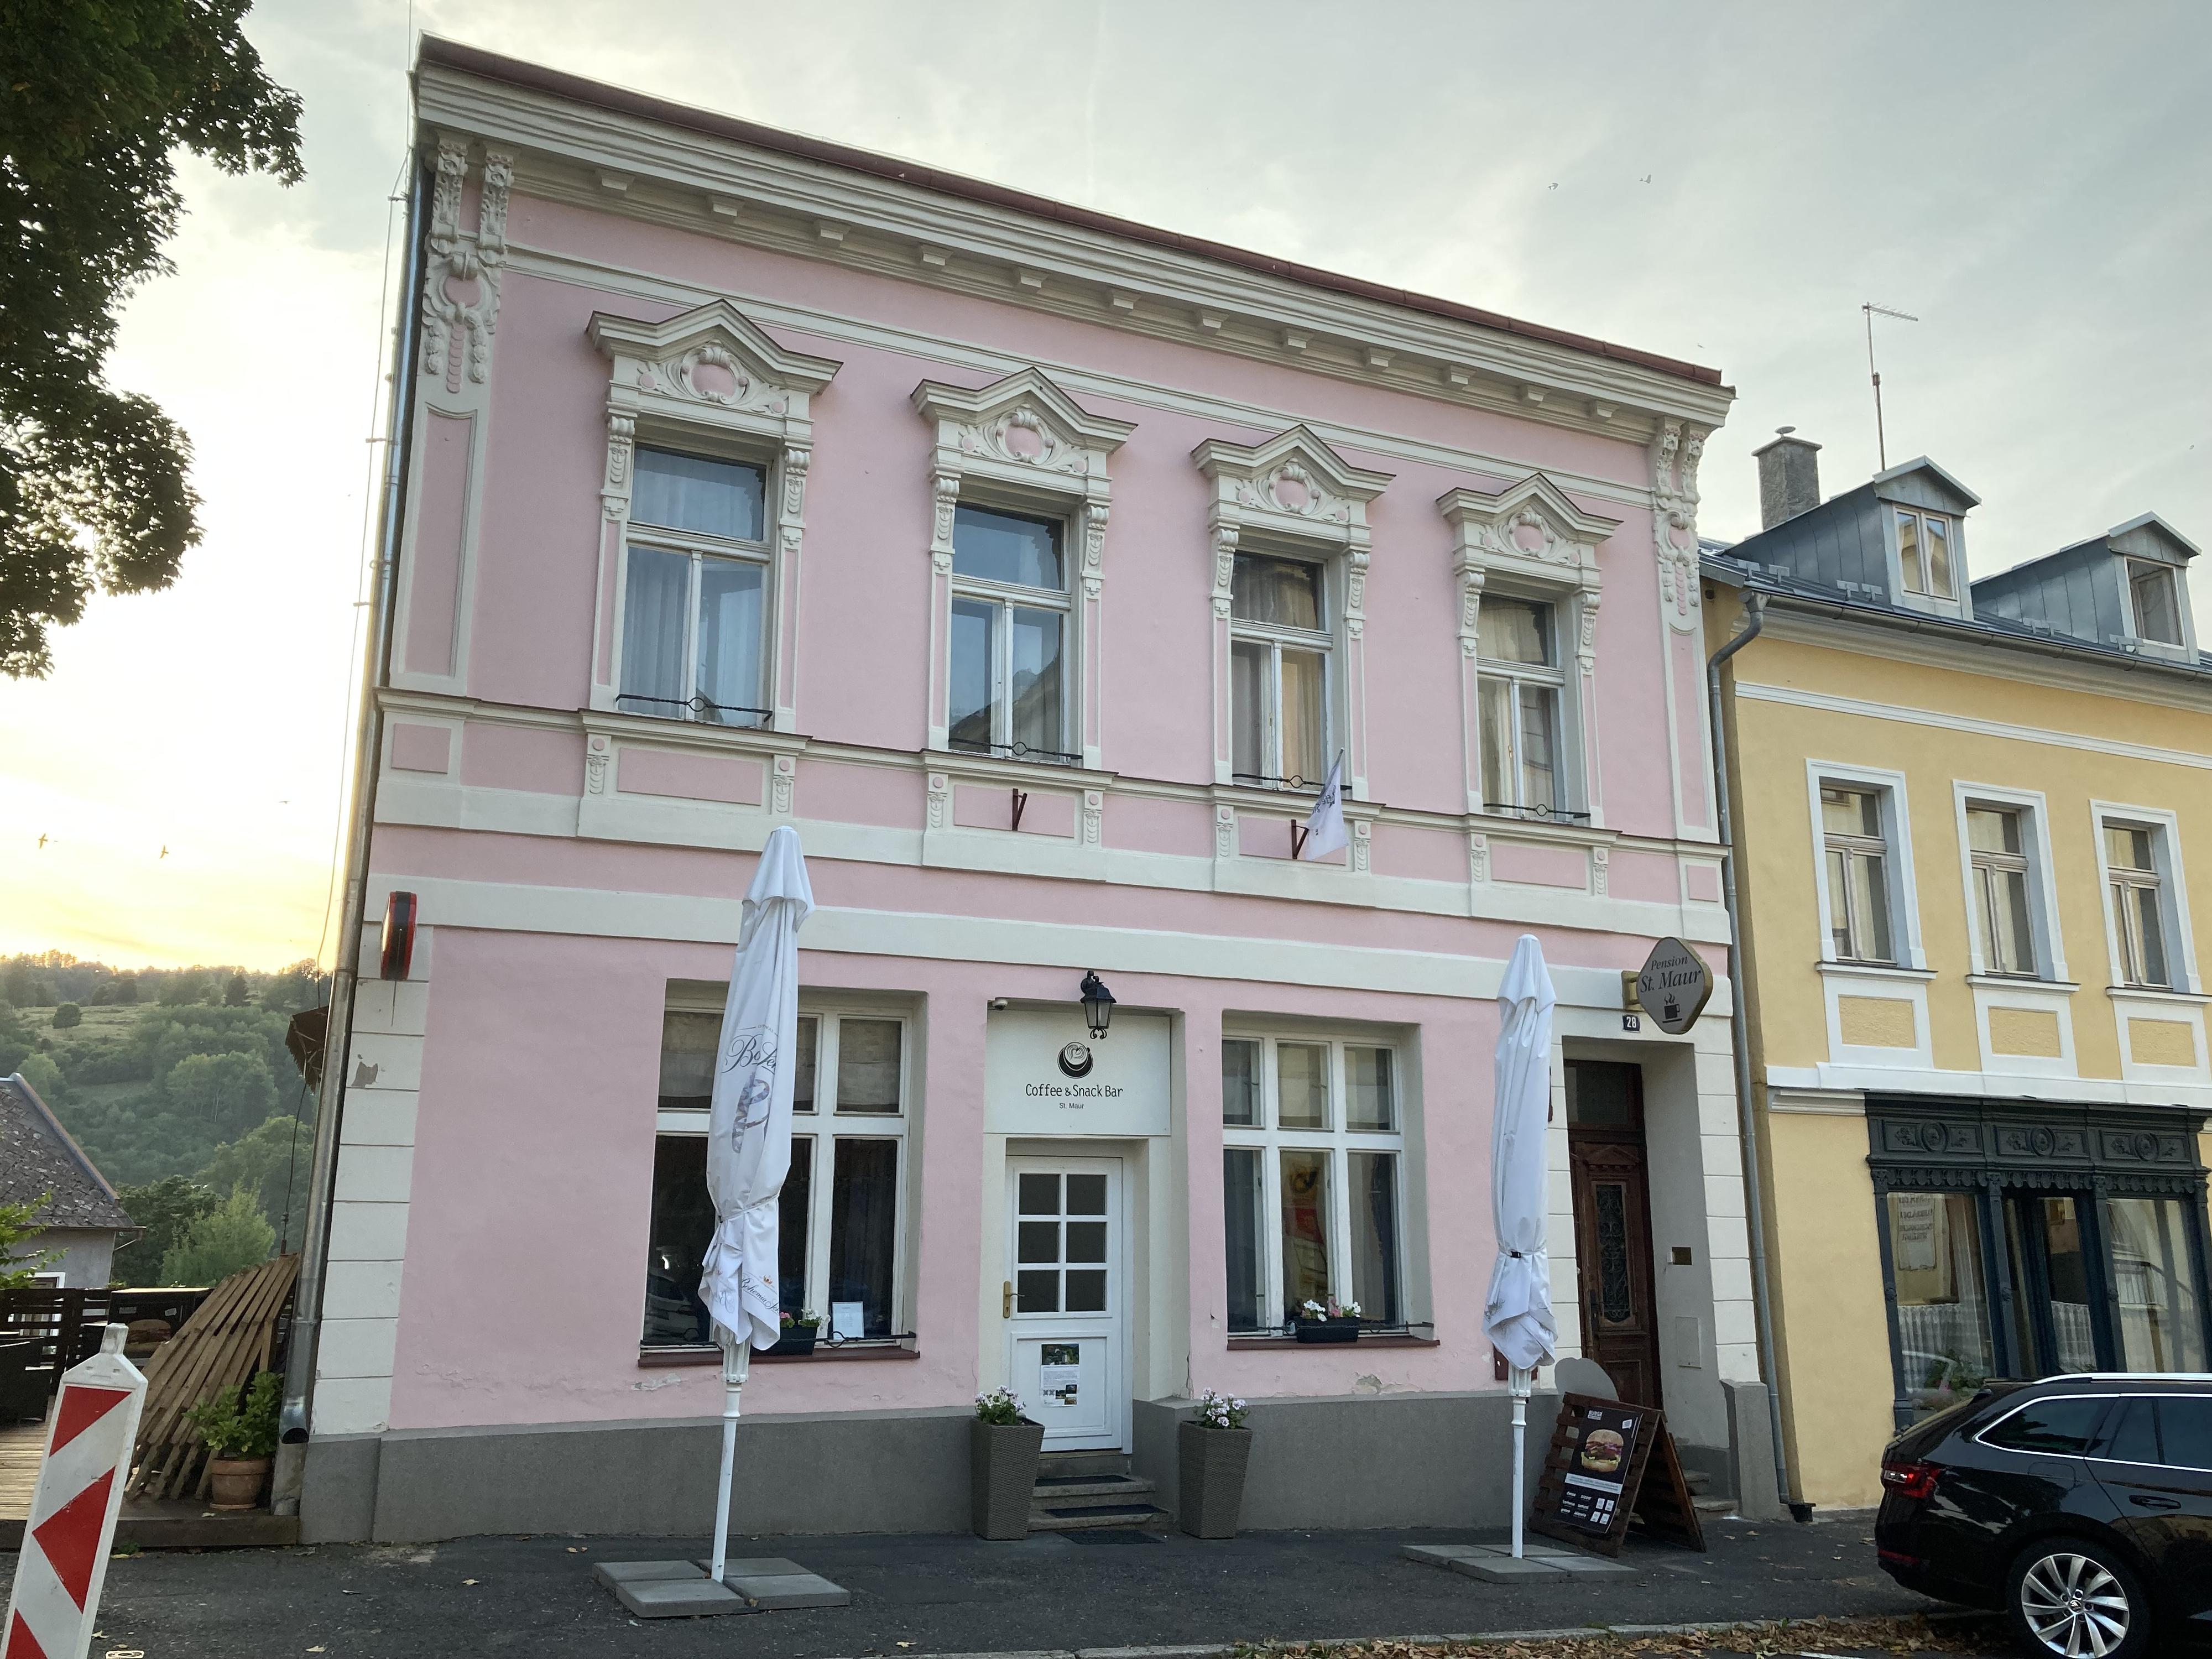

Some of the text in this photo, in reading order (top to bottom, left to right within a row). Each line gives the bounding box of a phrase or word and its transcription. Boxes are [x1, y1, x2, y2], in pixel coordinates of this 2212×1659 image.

[1651, 956, 1688, 971] Pension
[1640, 969, 1701, 993] St. Maur
[1626, 1016, 1637, 1028] 28
[1025, 1083, 1062, 1097] Coffee
[1072, 1084, 1103, 1097] Snack
[1105, 1085, 1124, 1098] Bar
